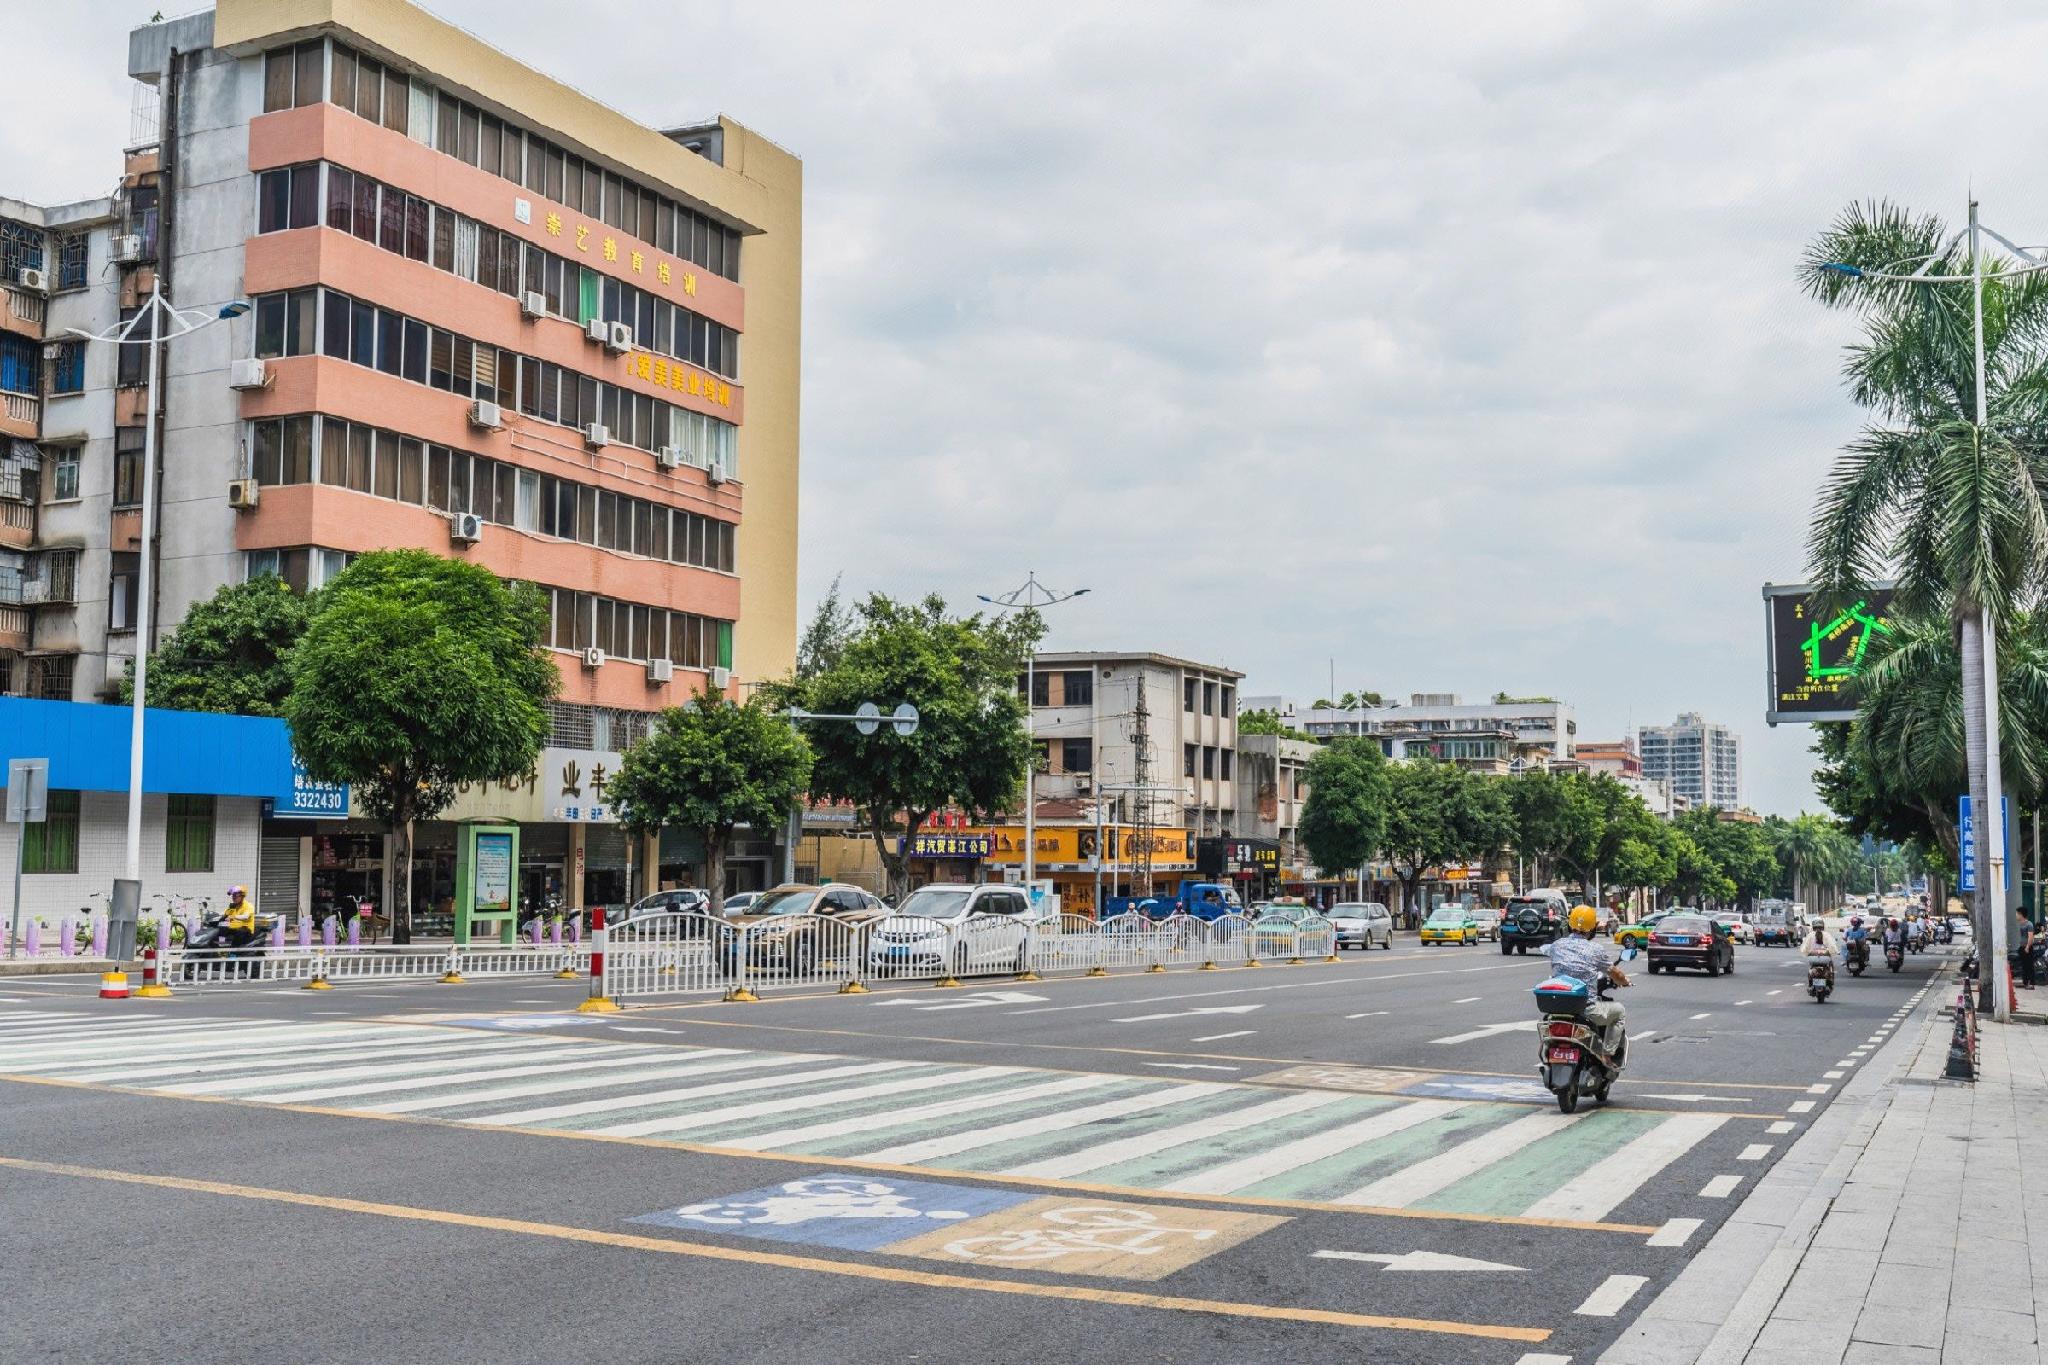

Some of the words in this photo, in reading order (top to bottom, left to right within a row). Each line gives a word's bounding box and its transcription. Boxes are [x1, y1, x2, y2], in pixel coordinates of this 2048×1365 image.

[294, 792, 342, 809] 3322430
[903, 839, 988, 855] 祥汽贸湛江公司
